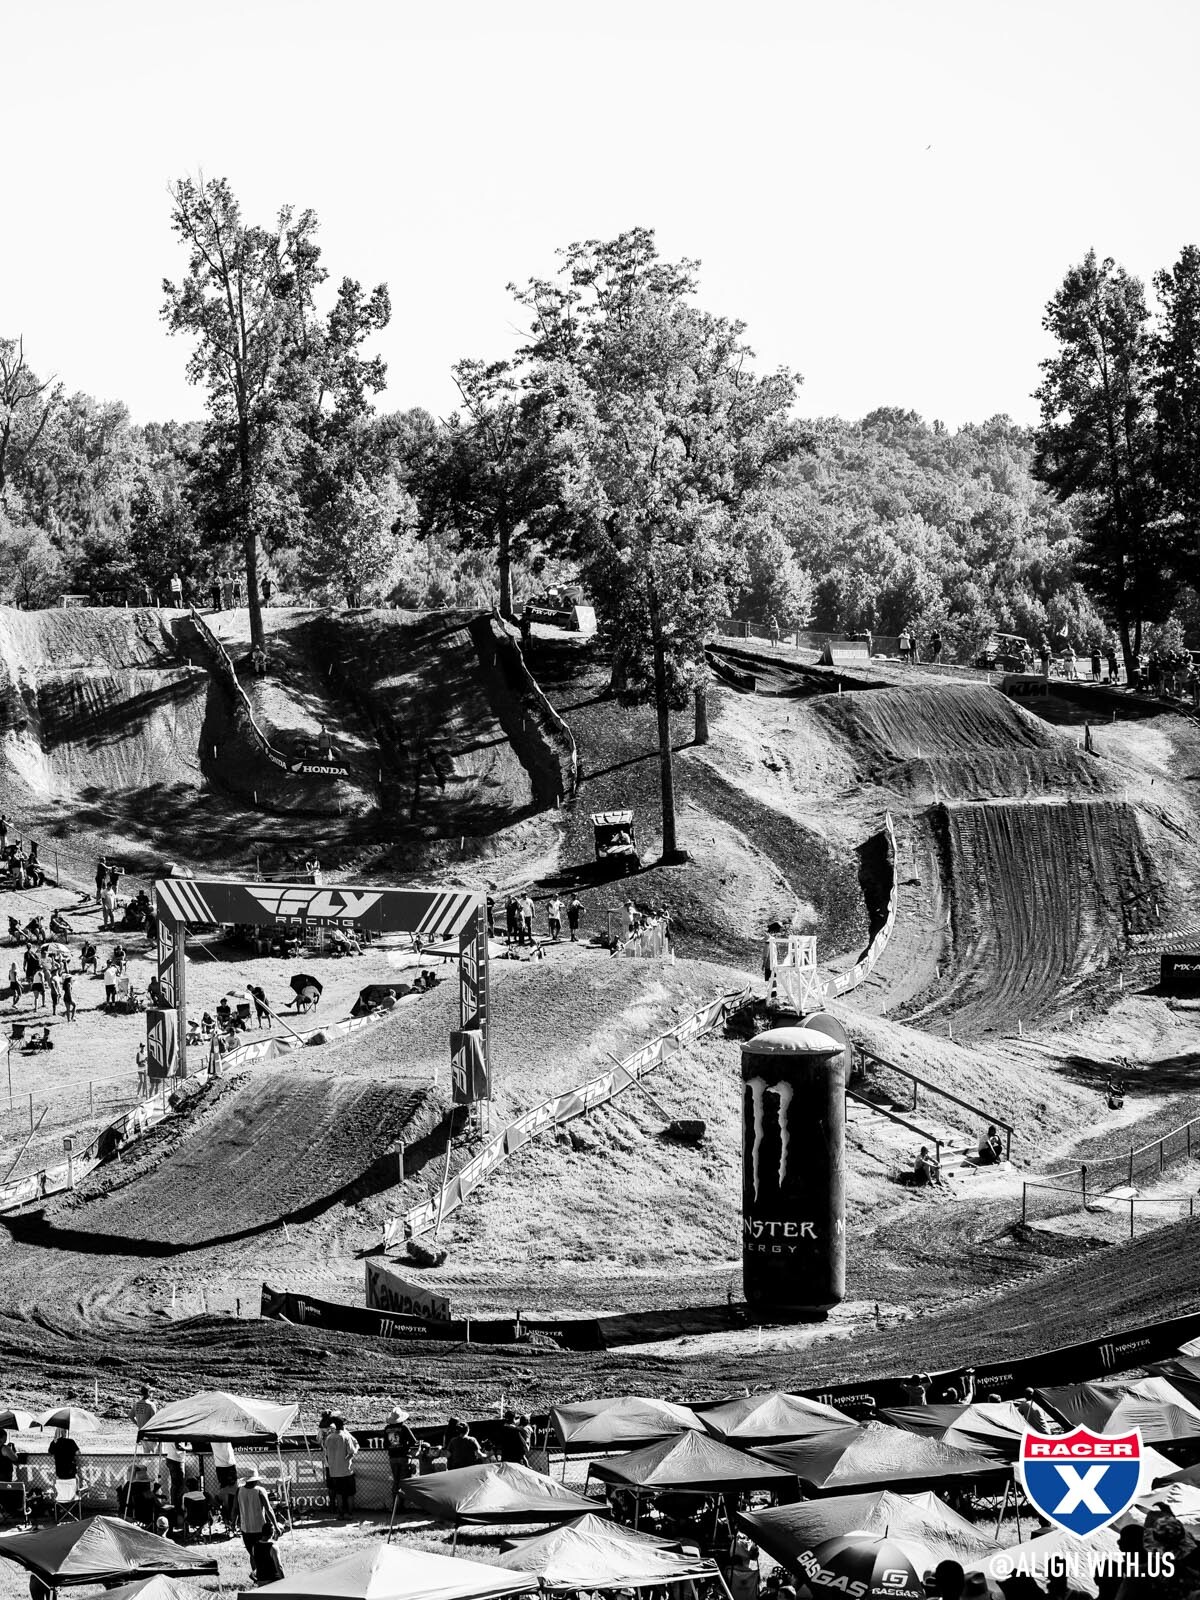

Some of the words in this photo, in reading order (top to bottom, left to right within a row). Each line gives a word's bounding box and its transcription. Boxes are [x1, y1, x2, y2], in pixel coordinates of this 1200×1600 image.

[303, 765, 349, 776] HONDA
[244, 887, 385, 918] FLY
[275, 916, 354, 927] RACING
[744, 1215, 818, 1240] NSTER
[393, 1324, 428, 1333] MONSTER
